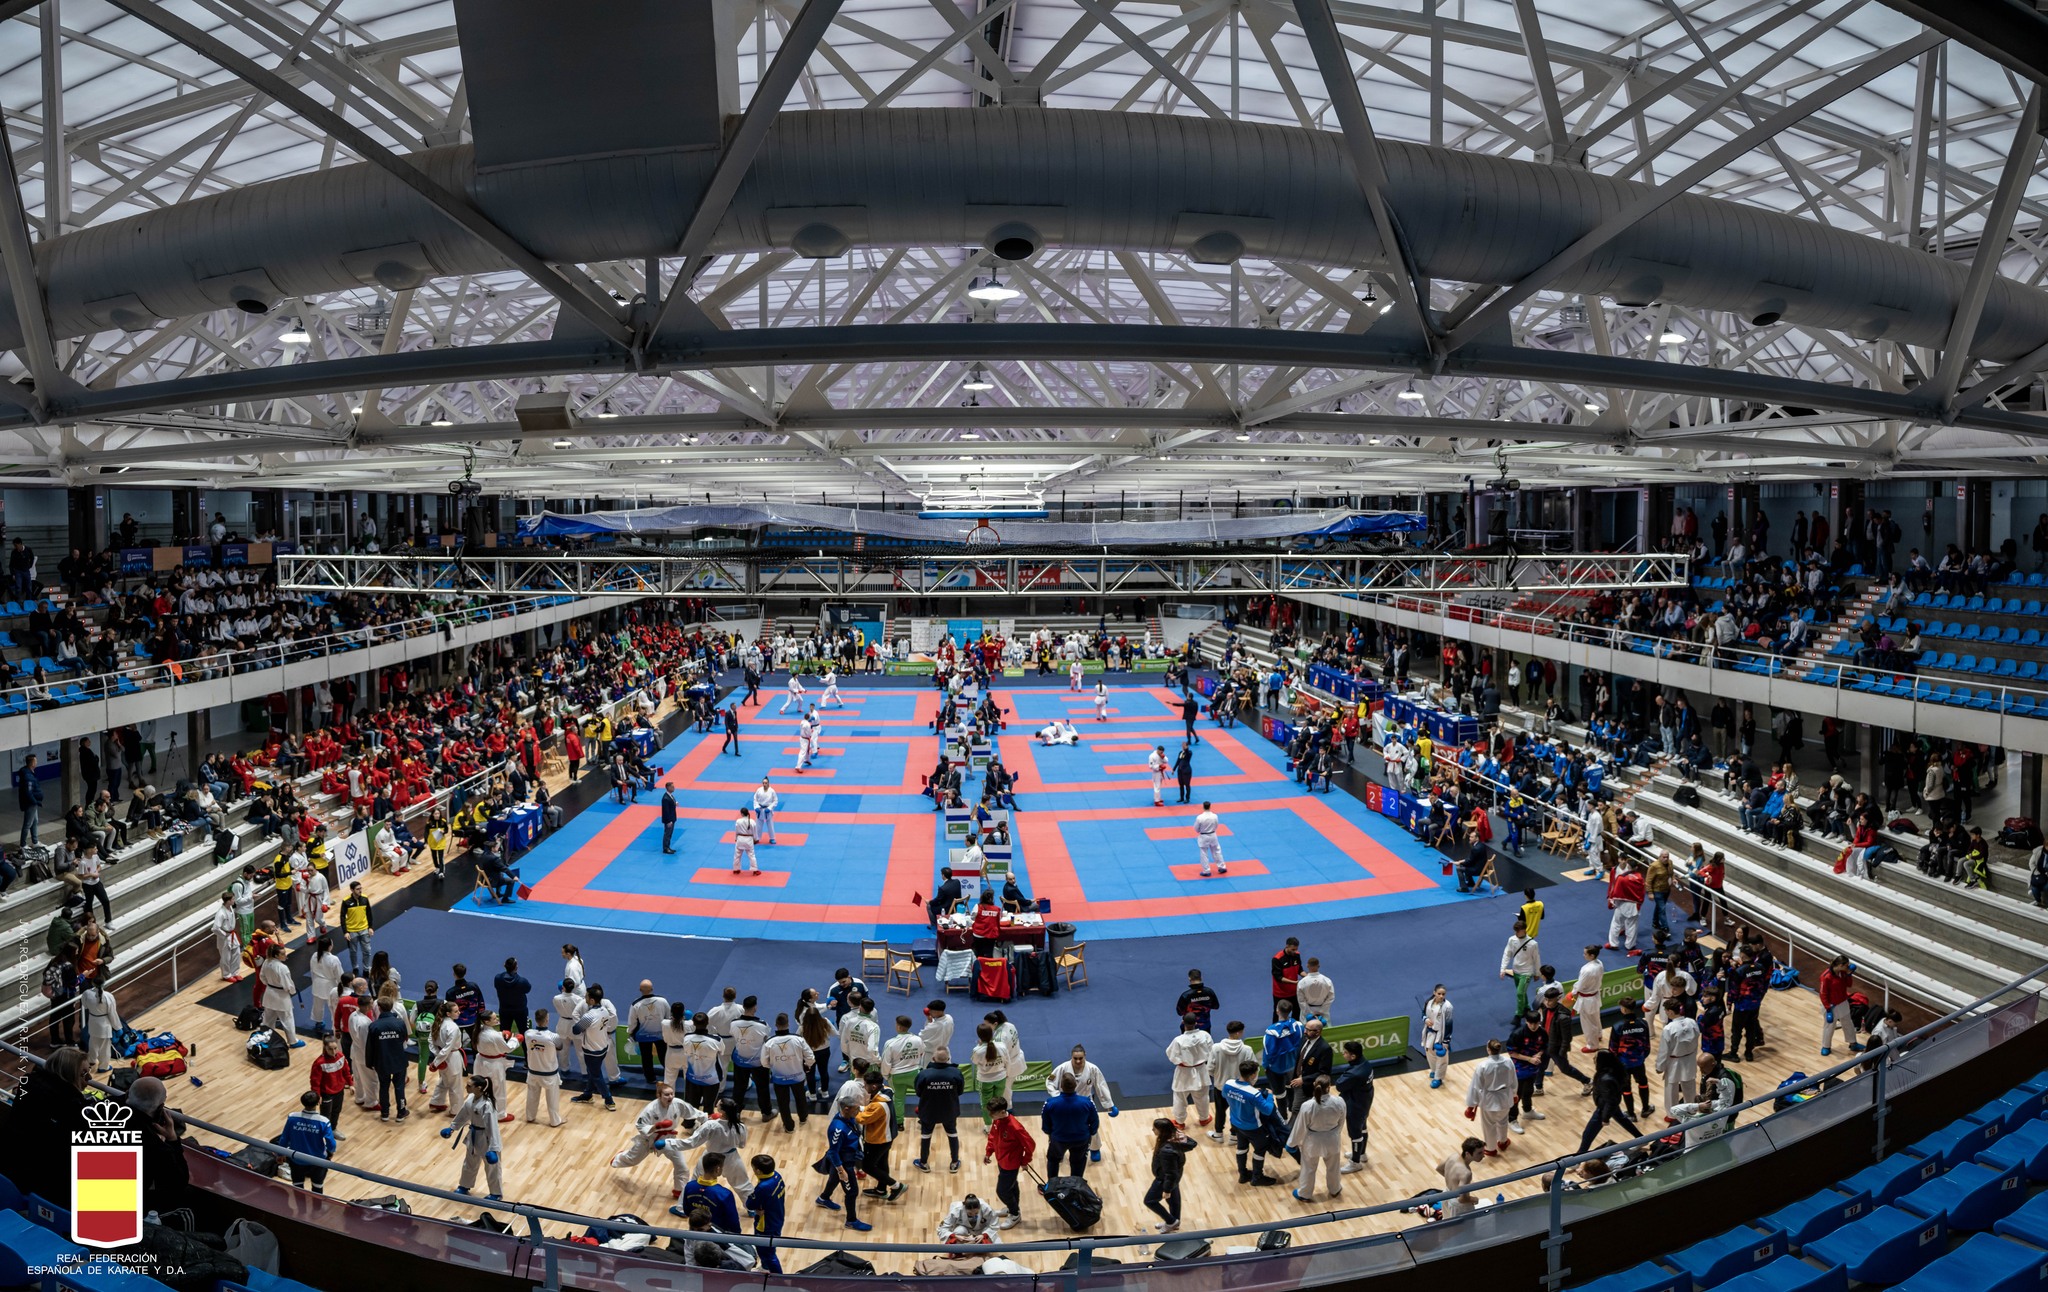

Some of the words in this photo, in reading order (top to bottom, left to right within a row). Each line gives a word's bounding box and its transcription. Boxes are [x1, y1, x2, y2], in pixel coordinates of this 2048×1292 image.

[1369, 791, 1376, 804] 2
[1389, 797, 1396, 810] 2
[337, 861, 358, 884] Dae
[356, 853, 369, 874] do
[456, 990, 475, 999] MADRID
[1622, 1027, 1645, 1036] MADRID
[292, 1125, 320, 1134] KARATE
[1988, 1127, 1996, 1136] 15
[1925, 1166, 1934, 1175] 16
[2006, 1178, 2015, 1189] 17
[1849, 1205, 1859, 1215] 17
[1924, 1228, 1936, 1241] 18
